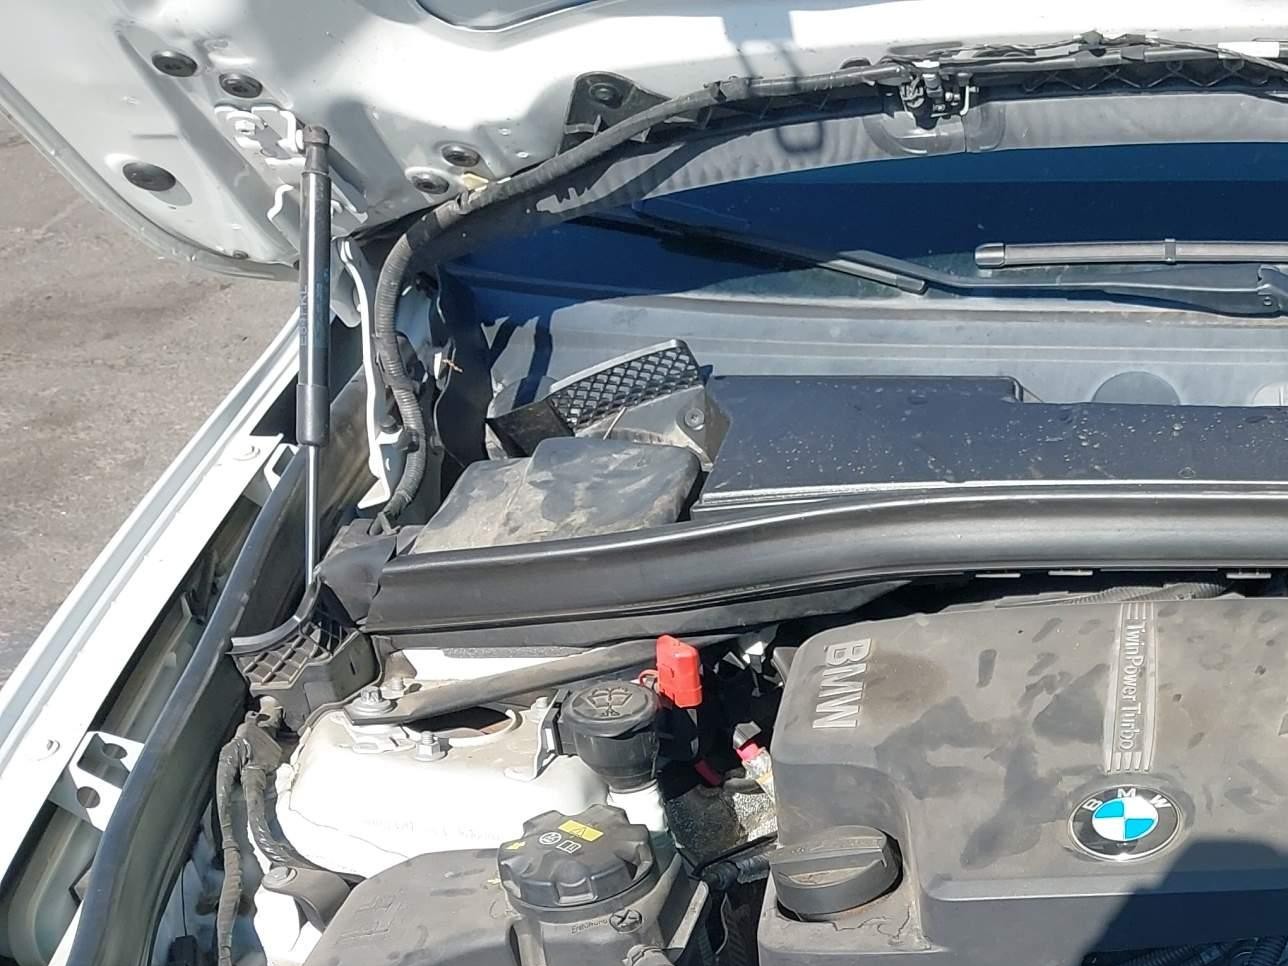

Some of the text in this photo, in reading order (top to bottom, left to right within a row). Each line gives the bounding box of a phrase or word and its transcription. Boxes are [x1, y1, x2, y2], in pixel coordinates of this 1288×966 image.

[812, 638, 872, 729] BMW
[1119, 621, 1146, 750] TwinPower Turbo
[1082, 787, 1173, 812] BMW
